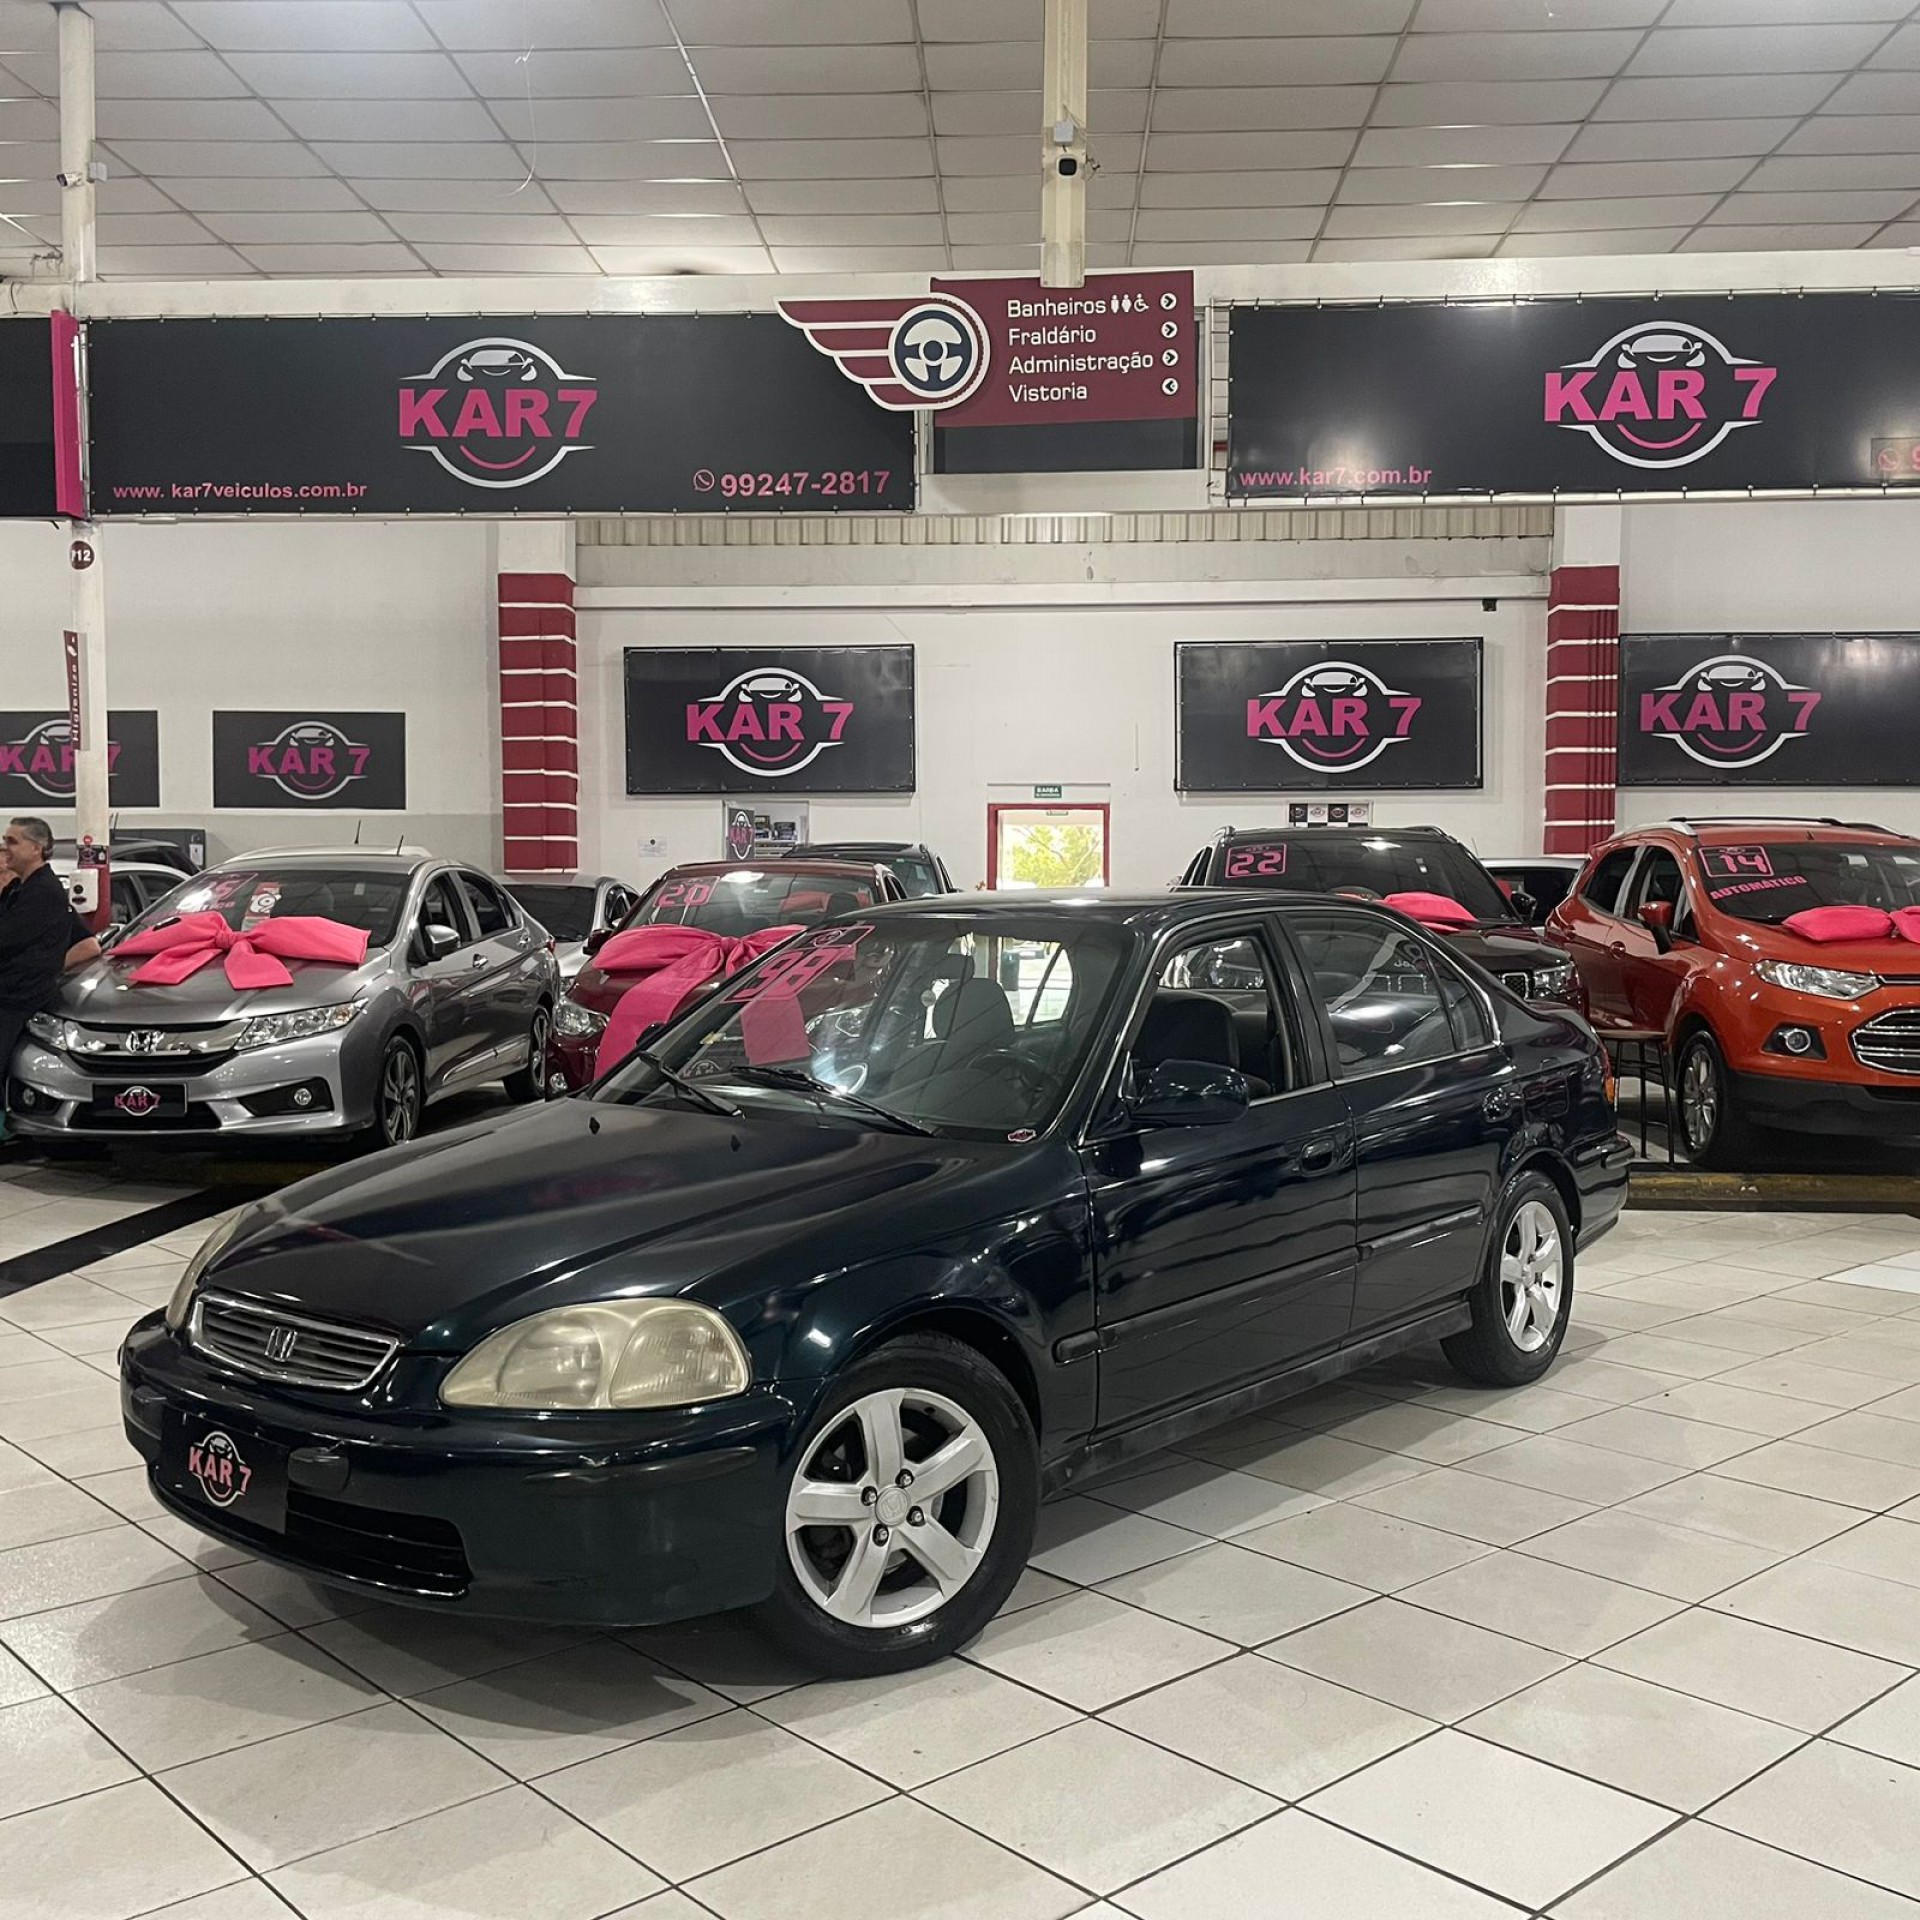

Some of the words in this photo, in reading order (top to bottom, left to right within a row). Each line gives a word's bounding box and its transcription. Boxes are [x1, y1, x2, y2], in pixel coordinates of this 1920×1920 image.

[1007, 298, 1106, 318] Banheiros
[1008, 324, 1097, 346] Fraldário
[1008, 352, 1153, 374] Administração
[1008, 382, 1087, 402] Vistoria
[1544, 369, 1708, 422] KAR
[1734, 367, 1777, 418] 7
[720, 470, 891, 498] 99247-2817
[1239, 465, 1433, 486] www.kar7.com.br
[171, 482, 367, 499] kar7veiculos.com.br
[686, 702, 805, 741] KAR
[822, 702, 854, 740] 7
[1247, 697, 1370, 737] KAR
[1389, 697, 1422, 736] 7
[1640, 692, 1768, 732] KAR
[1787, 692, 1822, 731] 7
[248, 746, 336, 775] KAR
[348, 747, 371, 775] 7
[1230, 851, 1282, 876] 22
[1719, 853, 1768, 873] 14
[658, 883, 710, 905] 20
[732, 949, 841, 999] 98
[114, 1095, 149, 1107] KAR
[153, 1094, 161, 1108] 7
[188, 1446, 233, 1488] KAR
[239, 1465, 252, 1493] 7
